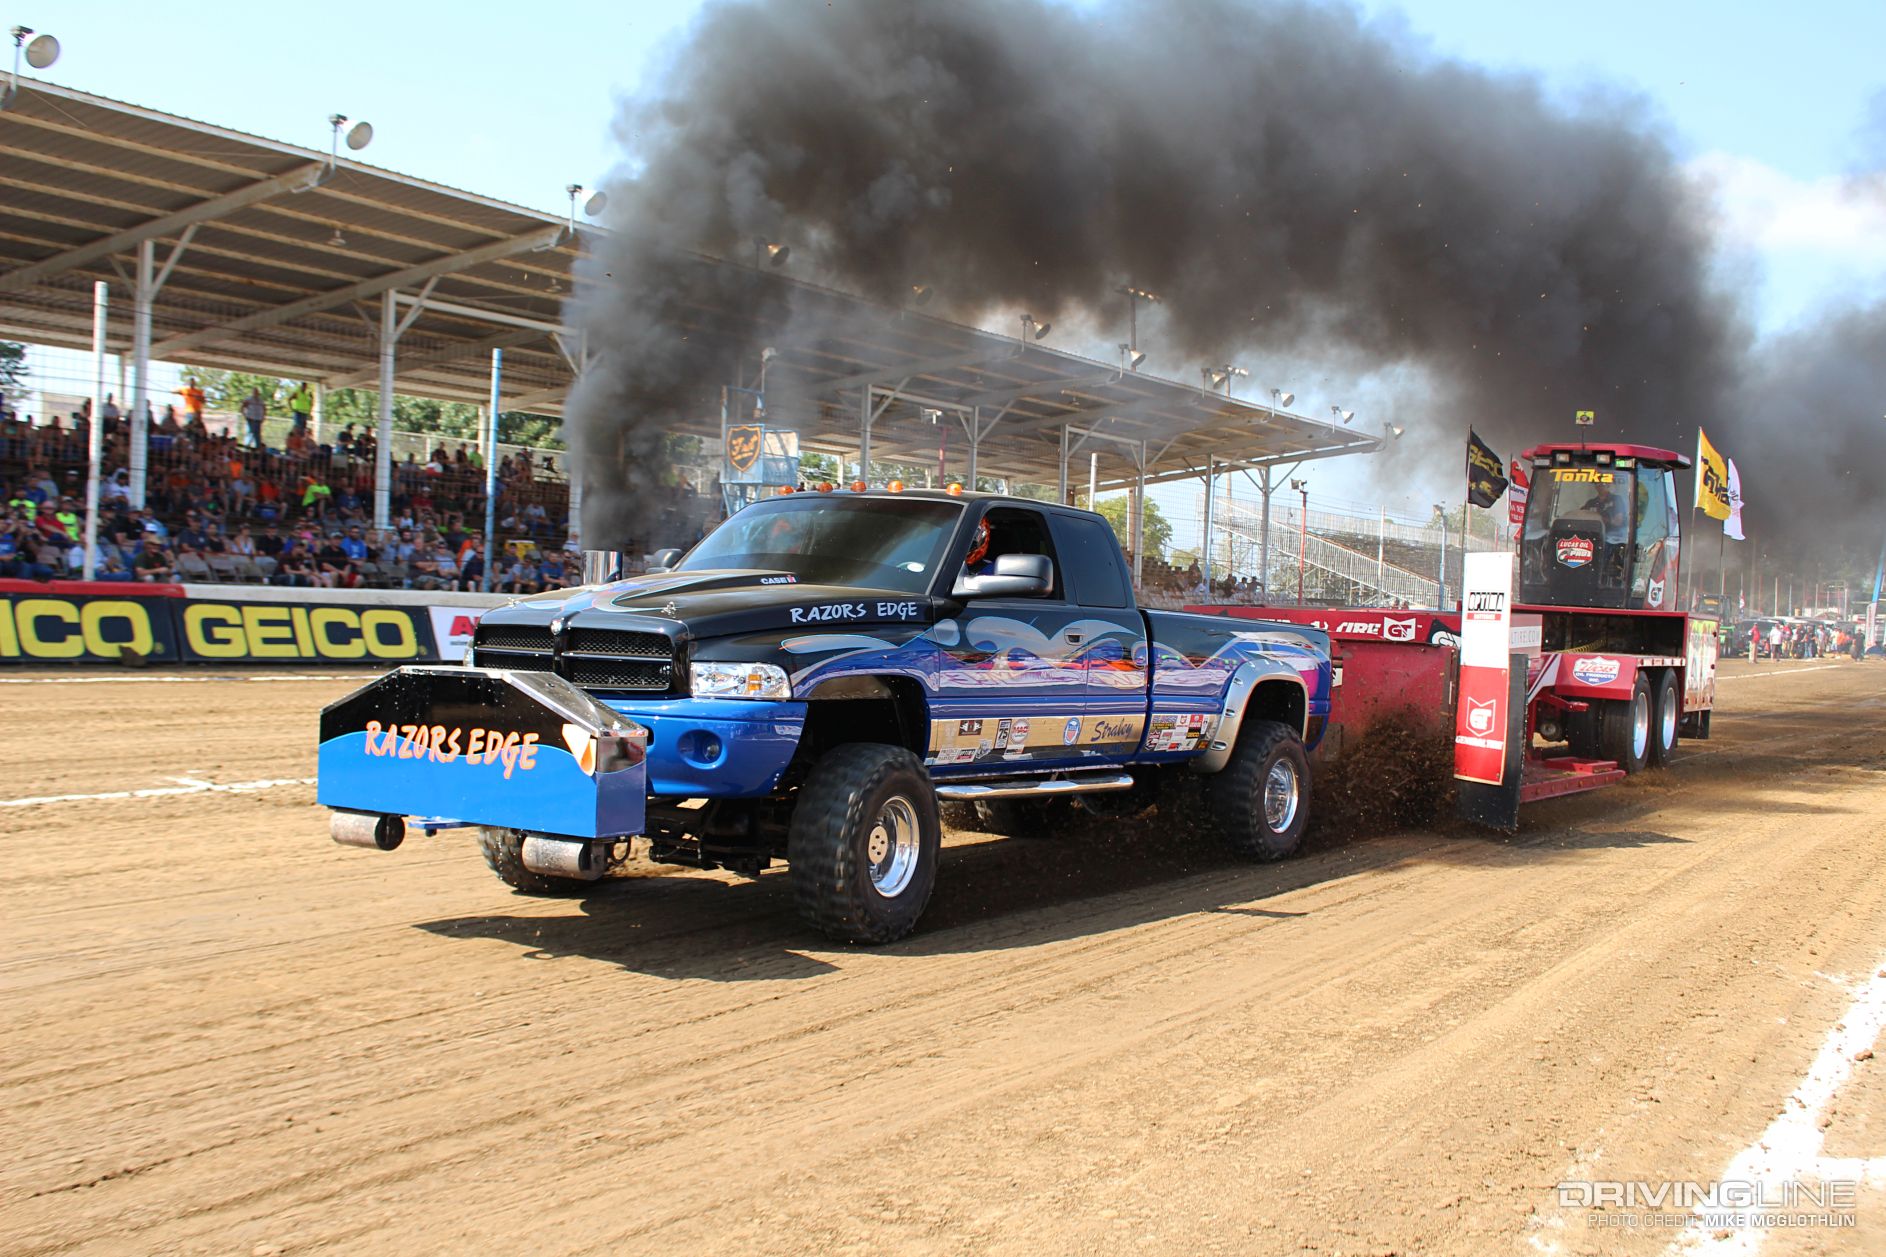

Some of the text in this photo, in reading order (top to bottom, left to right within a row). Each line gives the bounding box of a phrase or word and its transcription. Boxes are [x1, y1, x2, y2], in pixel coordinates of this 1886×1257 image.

[1549, 469, 1614, 483] Tonka
[1559, 541, 1589, 549] LUCAS OIL
[1467, 592, 1505, 611] OPTIMA
[789, 602, 918, 622] RAZORS EDGE
[184, 603, 418, 658] GEICO
[998, 728, 1009, 739] 75
[1090, 717, 1134, 742] Straley
[364, 720, 540, 779] RAZORS EDGE
